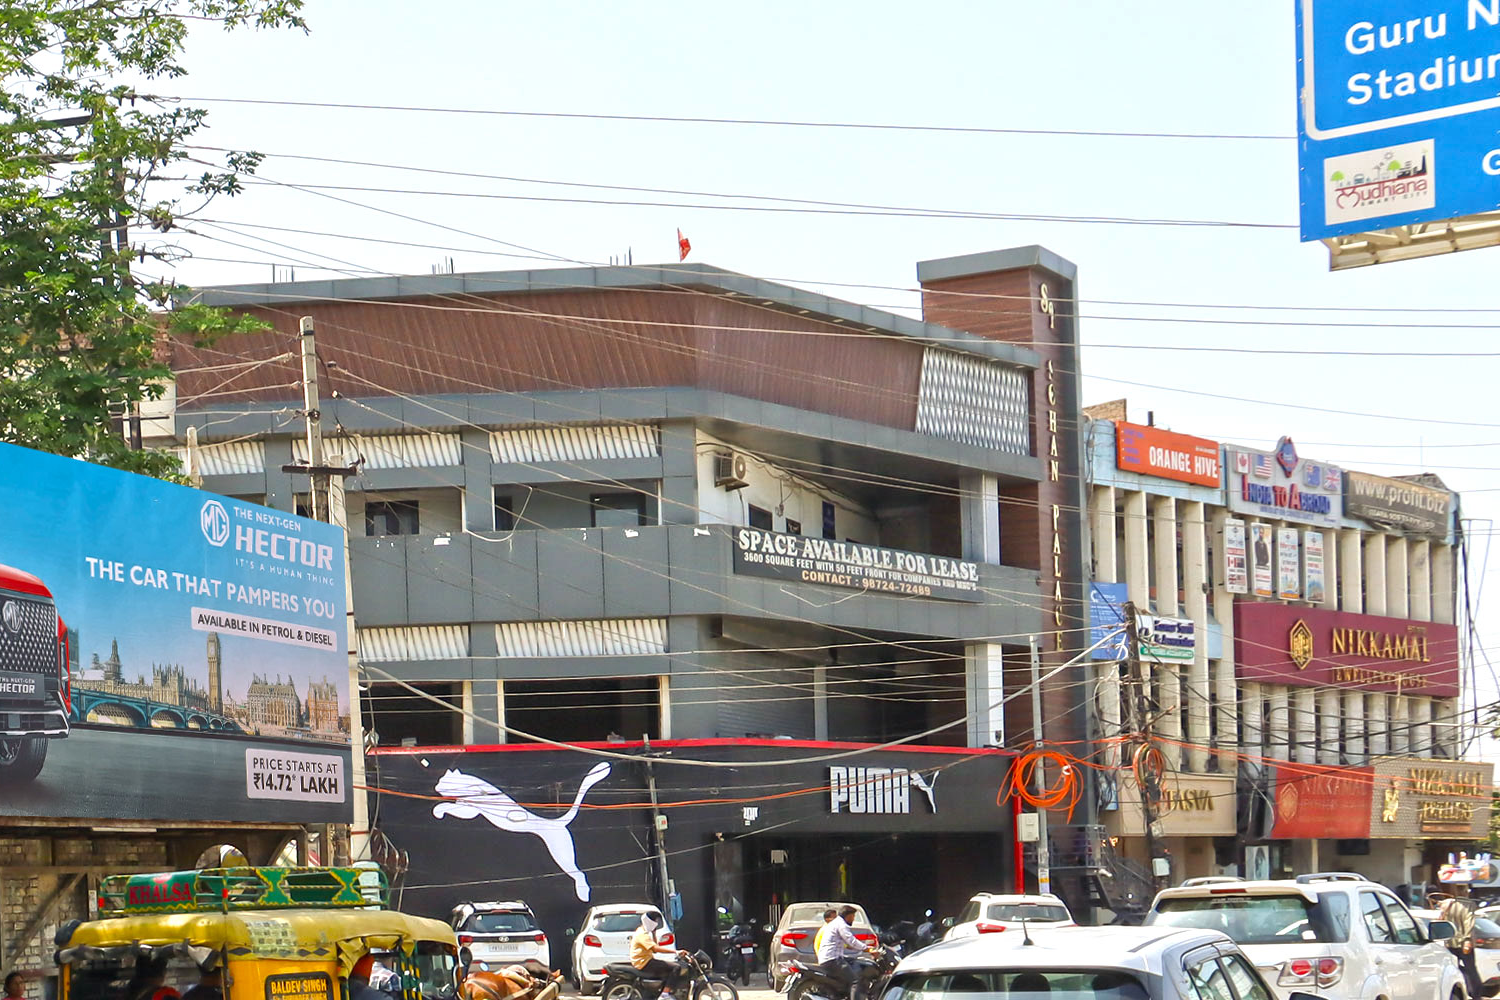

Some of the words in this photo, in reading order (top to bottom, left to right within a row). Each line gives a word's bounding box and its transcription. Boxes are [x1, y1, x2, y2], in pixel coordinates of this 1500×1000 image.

[1345, 13, 1447, 55] Guru
[1149, 445, 1192, 473] ORANGE
[1194, 455, 1219, 479] HIVE
[234, 506, 253, 521] THE
[256, 511, 301, 532] NEXT-GEN
[235, 525, 333, 571] HECTOR
[739, 529, 798, 557] SPACE
[802, 538, 893, 570] AVAILABLE
[895, 552, 928, 575] FOR
[930, 557, 979, 582] LEASE
[235, 558, 255, 570] IT'S
[260, 563, 266, 571] A
[269, 565, 302, 579] HUMAN
[307, 572, 335, 586] THING
[765, 554, 794, 567] SQUARE
[796, 559, 814, 570] FEET
[816, 561, 834, 572] WITH
[836, 563, 845, 574] 50
[847, 565, 864, 576] FEET
[865, 568, 887, 580] FRONT
[889, 571, 902, 581] FOR
[904, 573, 941, 586] COMPANIES
[802, 570, 852, 585] CONTACT
[862, 578, 931, 596] 98724-72489
[86, 557, 125, 583] THE
[130, 565, 169, 590] CAR
[172, 572, 222, 598] THAT
[227, 582, 299, 613] PAMPERS
[302, 597, 335, 619] YOU
[197, 613, 247, 632] AVAILABLE
[249, 622, 260, 634] IN
[262, 624, 295, 640] PETROL
[297, 630, 303, 641] &
[305, 631, 333, 647] DIESEL
[1332, 627, 1431, 663] NIKKAMAL
[0, 683, 35, 694] HECTOR
[253, 757, 282, 771] PRICE
[286, 760, 323, 774] STARTS
[326, 763, 337, 775] AT
[300, 776, 338, 795] LAKH
[829, 766, 910, 814] PUMA
[129, 882, 192, 905] KHALSA
[271, 980, 300, 995] BALDEV
[302, 979, 327, 993] SINGH
